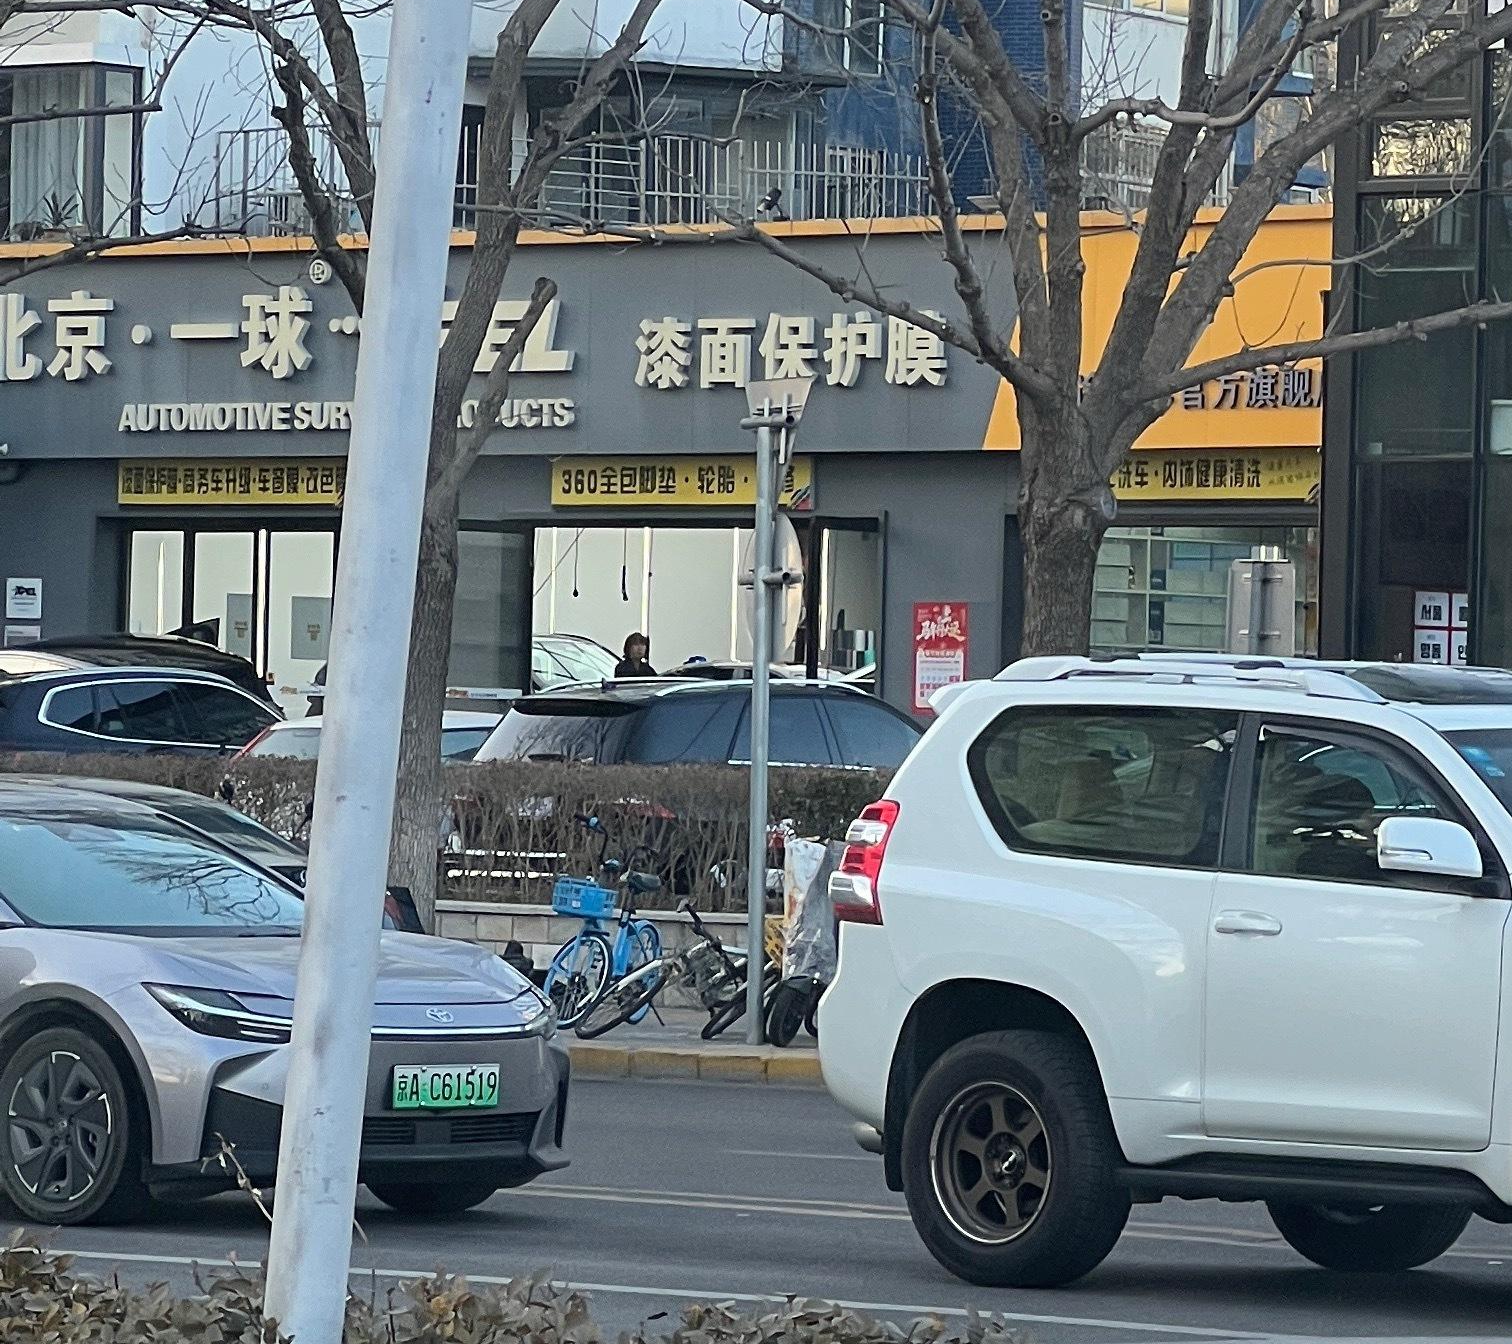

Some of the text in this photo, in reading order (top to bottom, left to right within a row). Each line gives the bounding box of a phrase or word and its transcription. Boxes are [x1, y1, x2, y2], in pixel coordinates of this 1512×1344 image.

[634, 310, 949, 389] 漆面保护膜
[118, 401, 352, 432] AUTOMOTIVE SUR
[1109, 458, 1261, 488] 洗车·内饰健康清洗
[397, 1071, 497, 1102] 京A C61519
